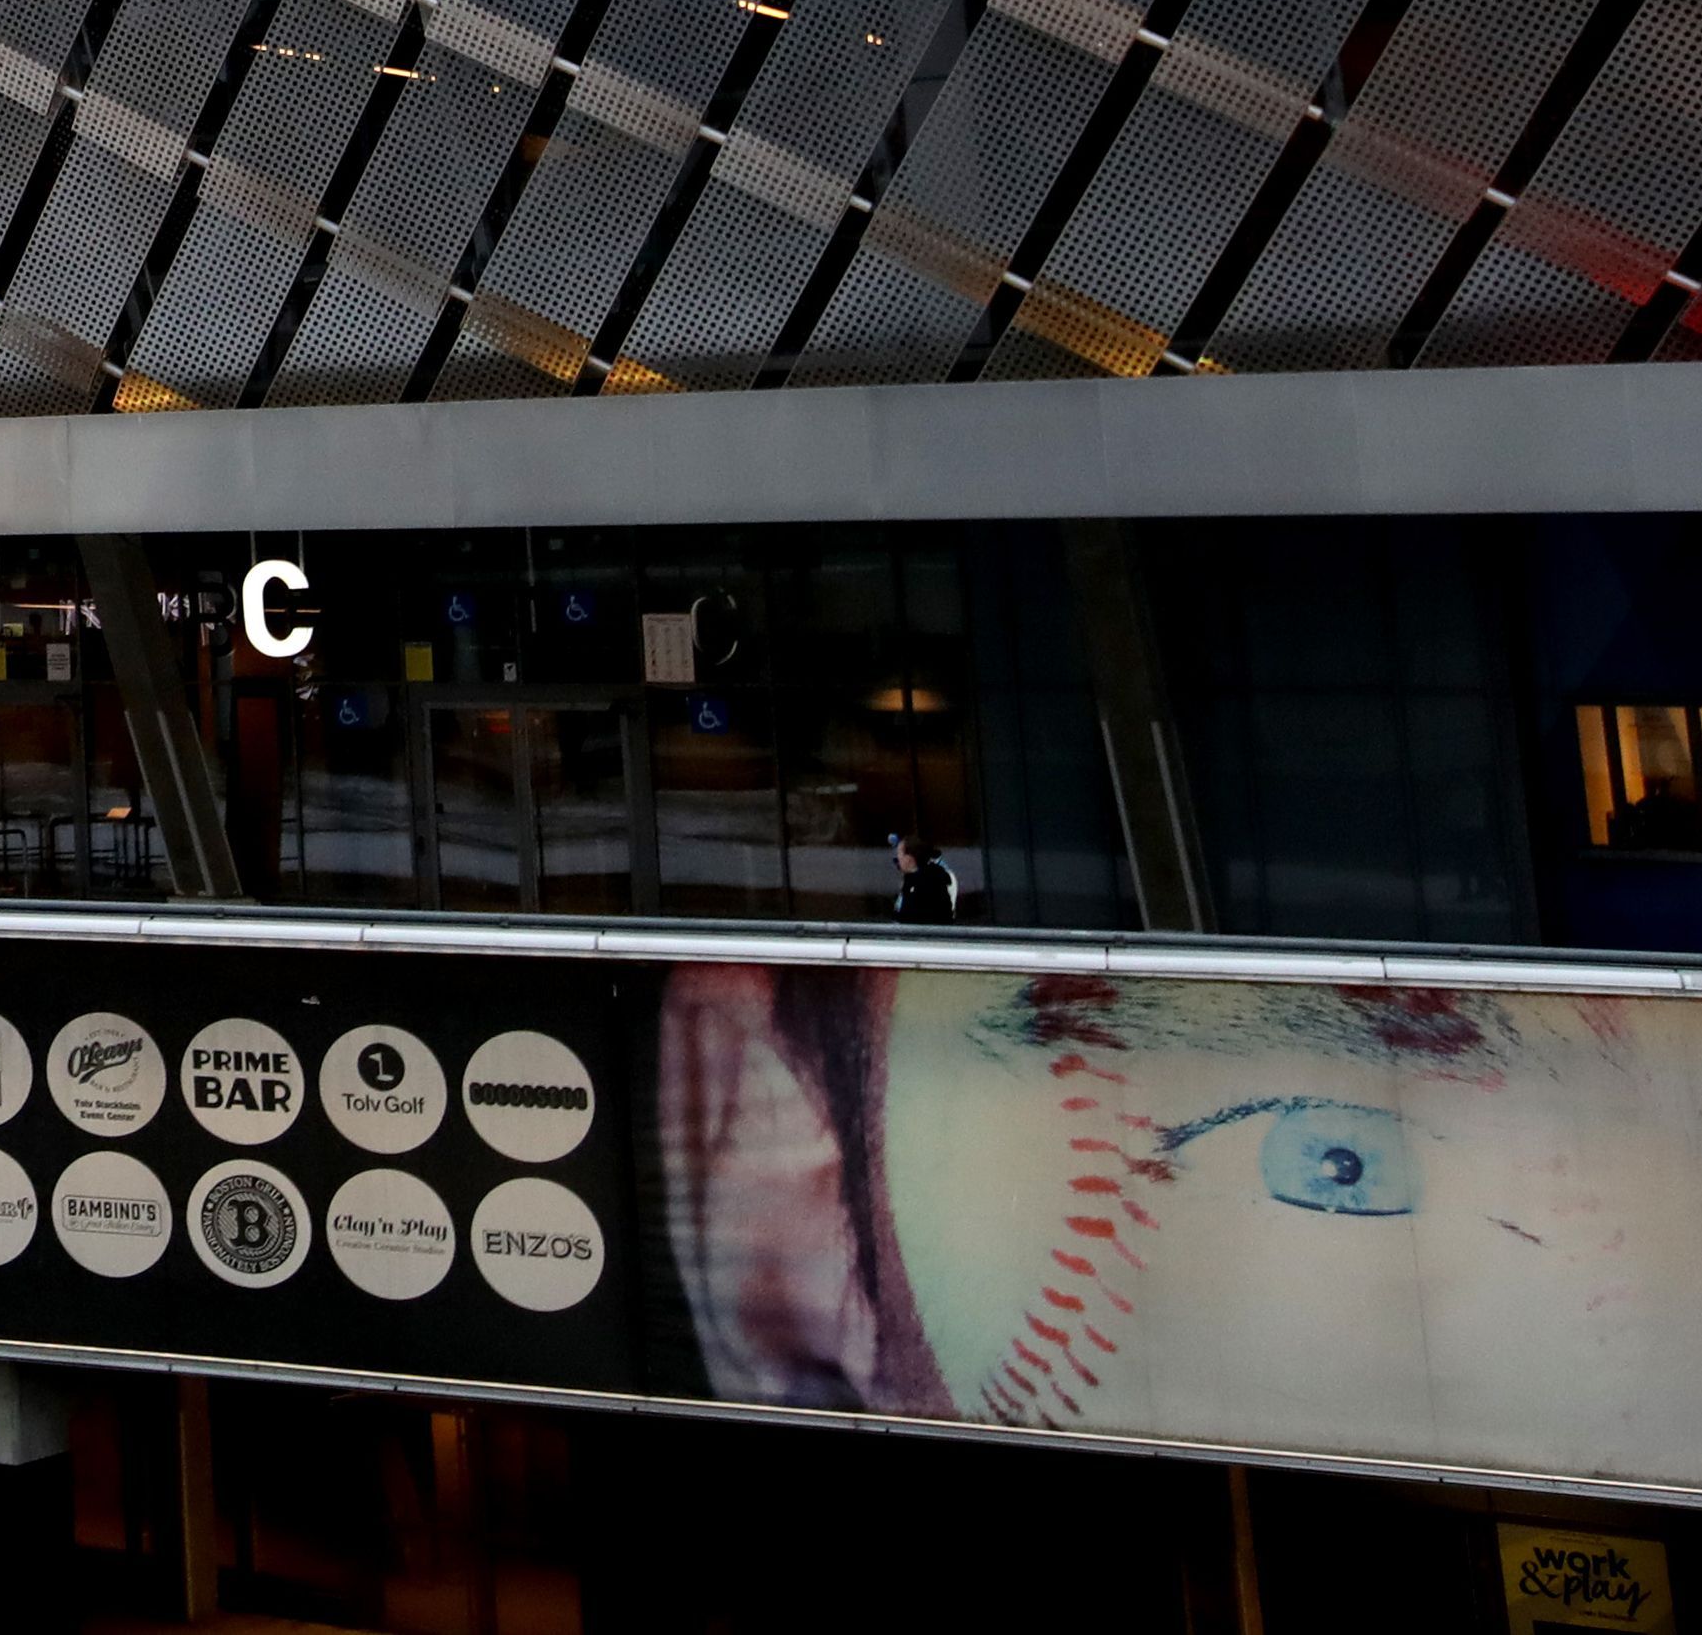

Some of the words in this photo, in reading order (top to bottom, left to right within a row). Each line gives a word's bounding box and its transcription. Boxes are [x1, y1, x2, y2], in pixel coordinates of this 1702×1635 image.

[242, 559, 314, 658] C
[192, 1049, 291, 1074] PRIME
[193, 1076, 292, 1113] BAR
[342, 1093, 380, 1112] Tolv
[384, 1095, 425, 1114] Golf
[209, 1177, 252, 1202] BOSTON
[255, 1179, 286, 1207] GRILL
[68, 1199, 157, 1221] BAMBINO'S
[397, 1218, 448, 1242] Play
[483, 1228, 593, 1261] ENZO'S
[1532, 1546, 1632, 1580] work
[1519, 1560, 1562, 1599] &
[1562, 1570, 1652, 1617] play
